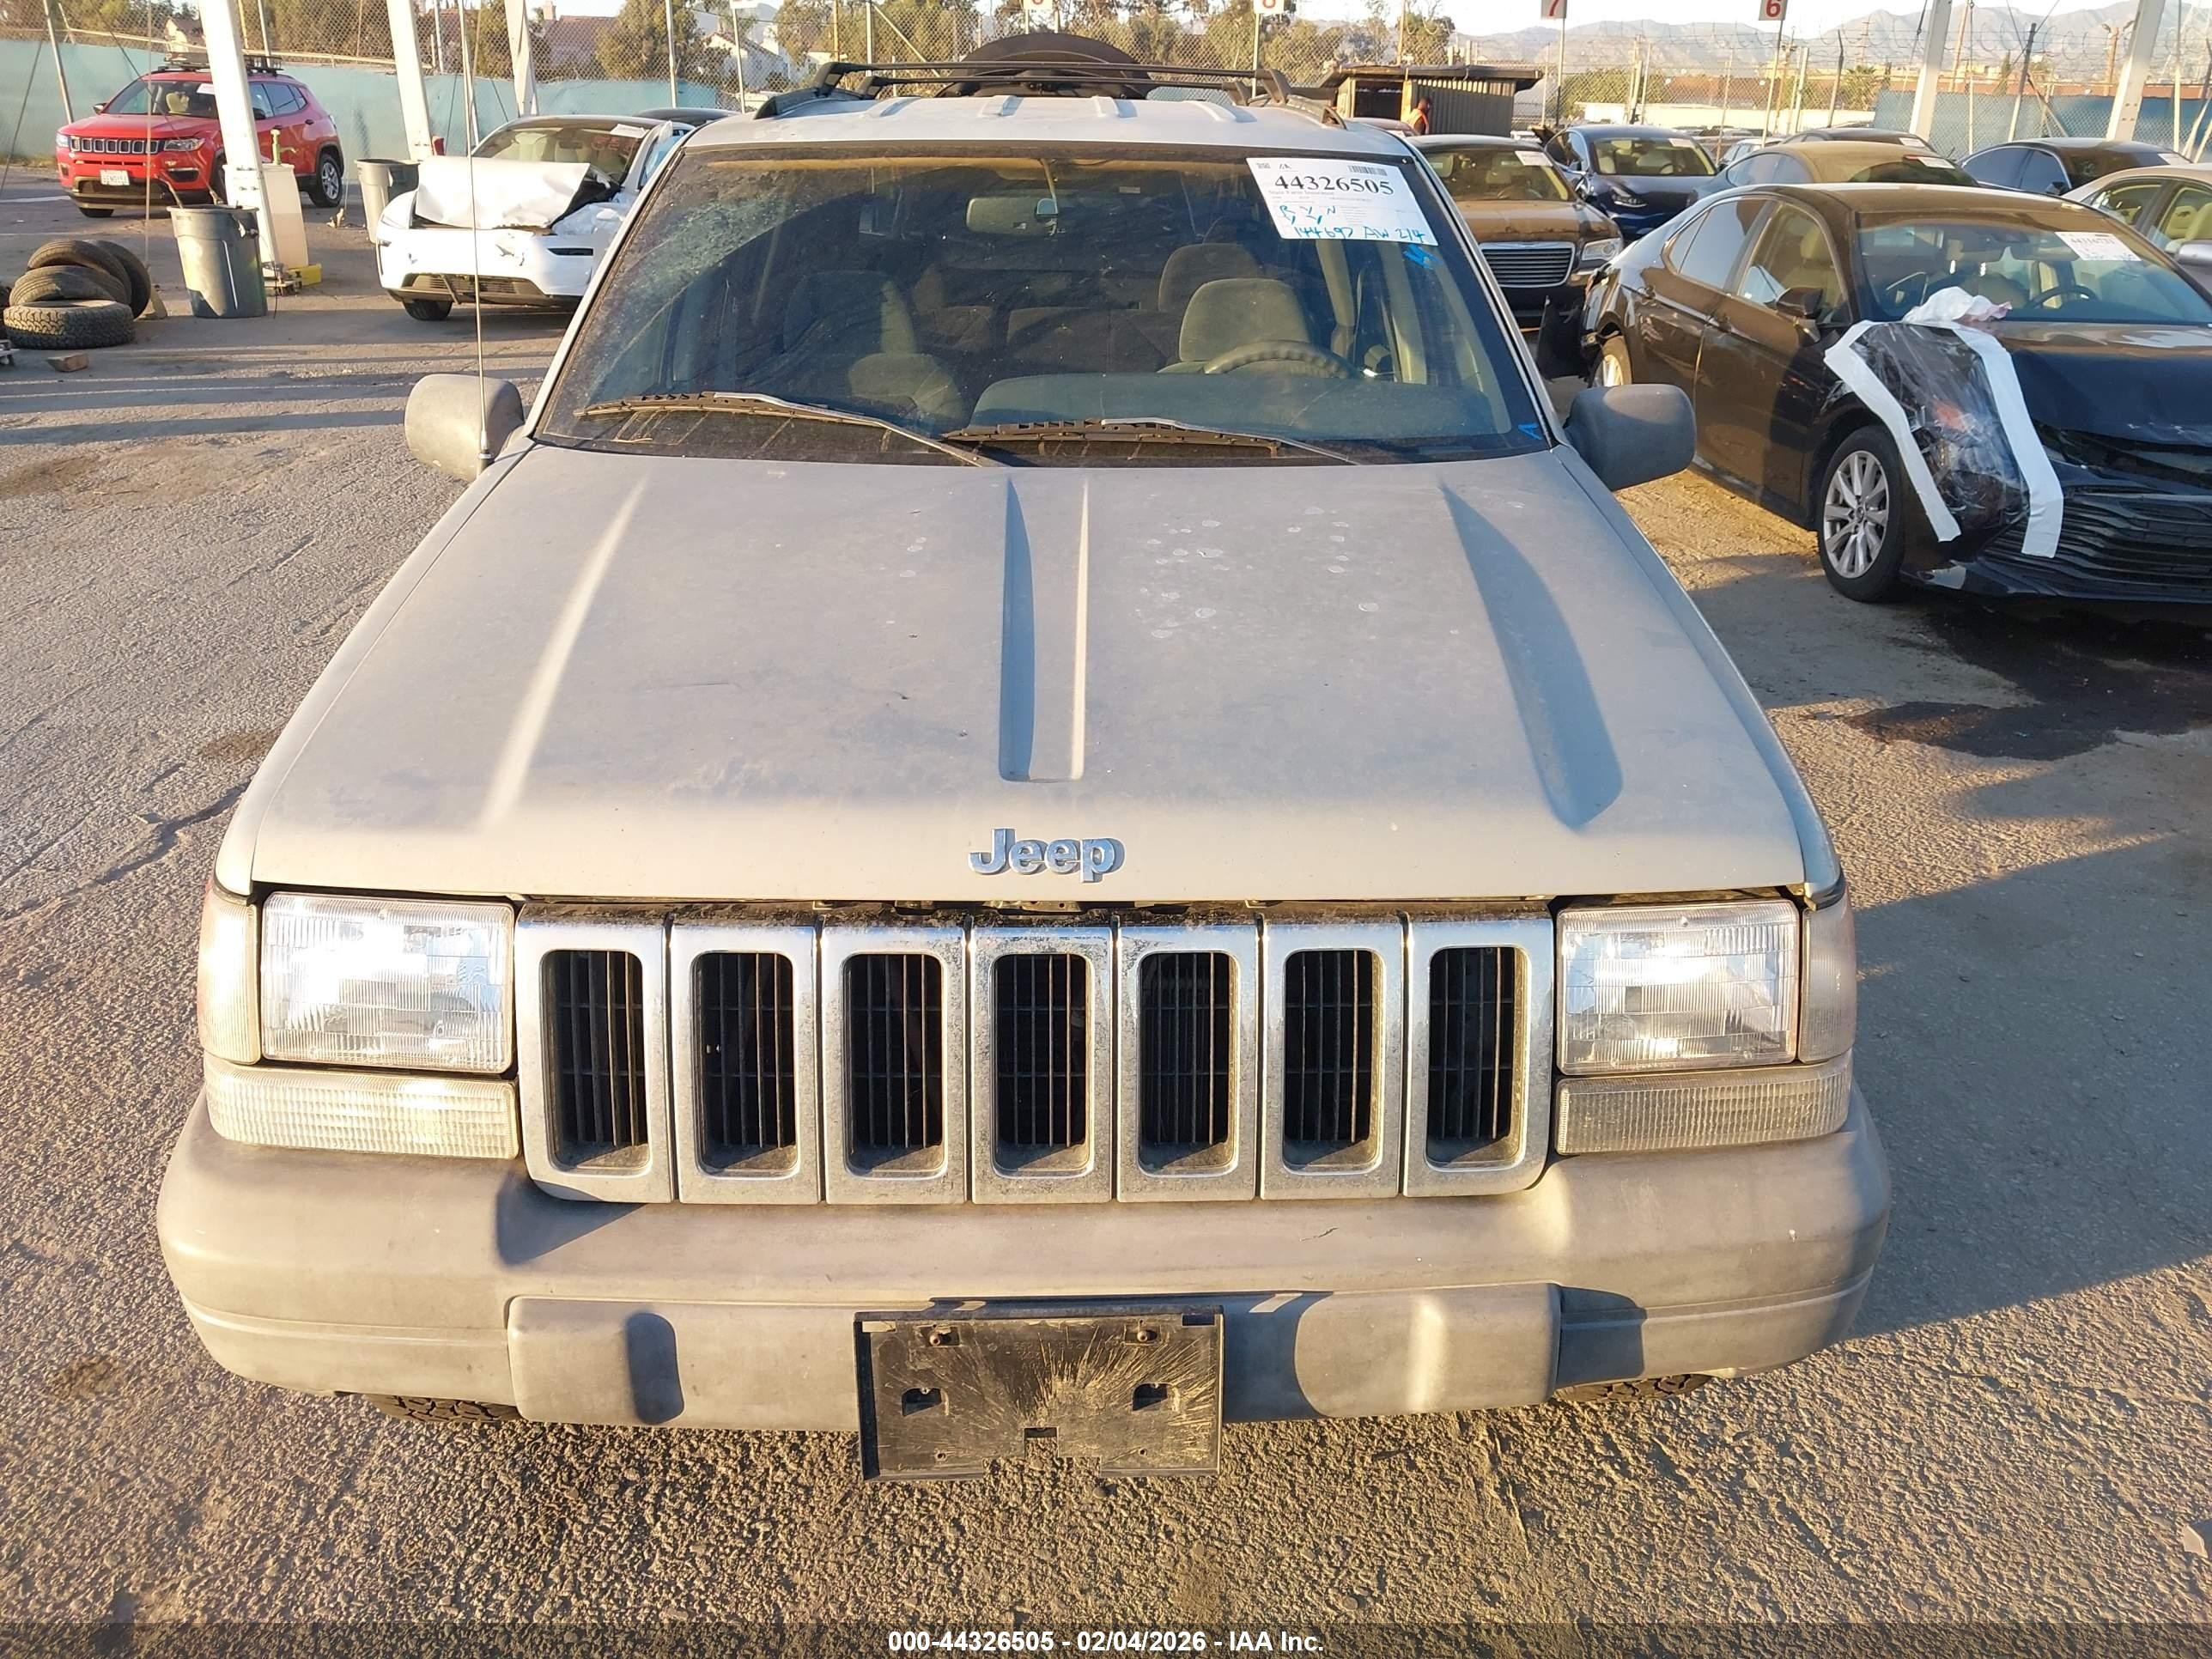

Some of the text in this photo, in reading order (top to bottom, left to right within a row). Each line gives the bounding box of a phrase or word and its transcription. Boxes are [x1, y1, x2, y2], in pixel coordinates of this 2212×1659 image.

[1765, 0, 1781, 17] 6
[1275, 175, 1394, 195] 44326505
[969, 828, 1125, 883] Jeep
